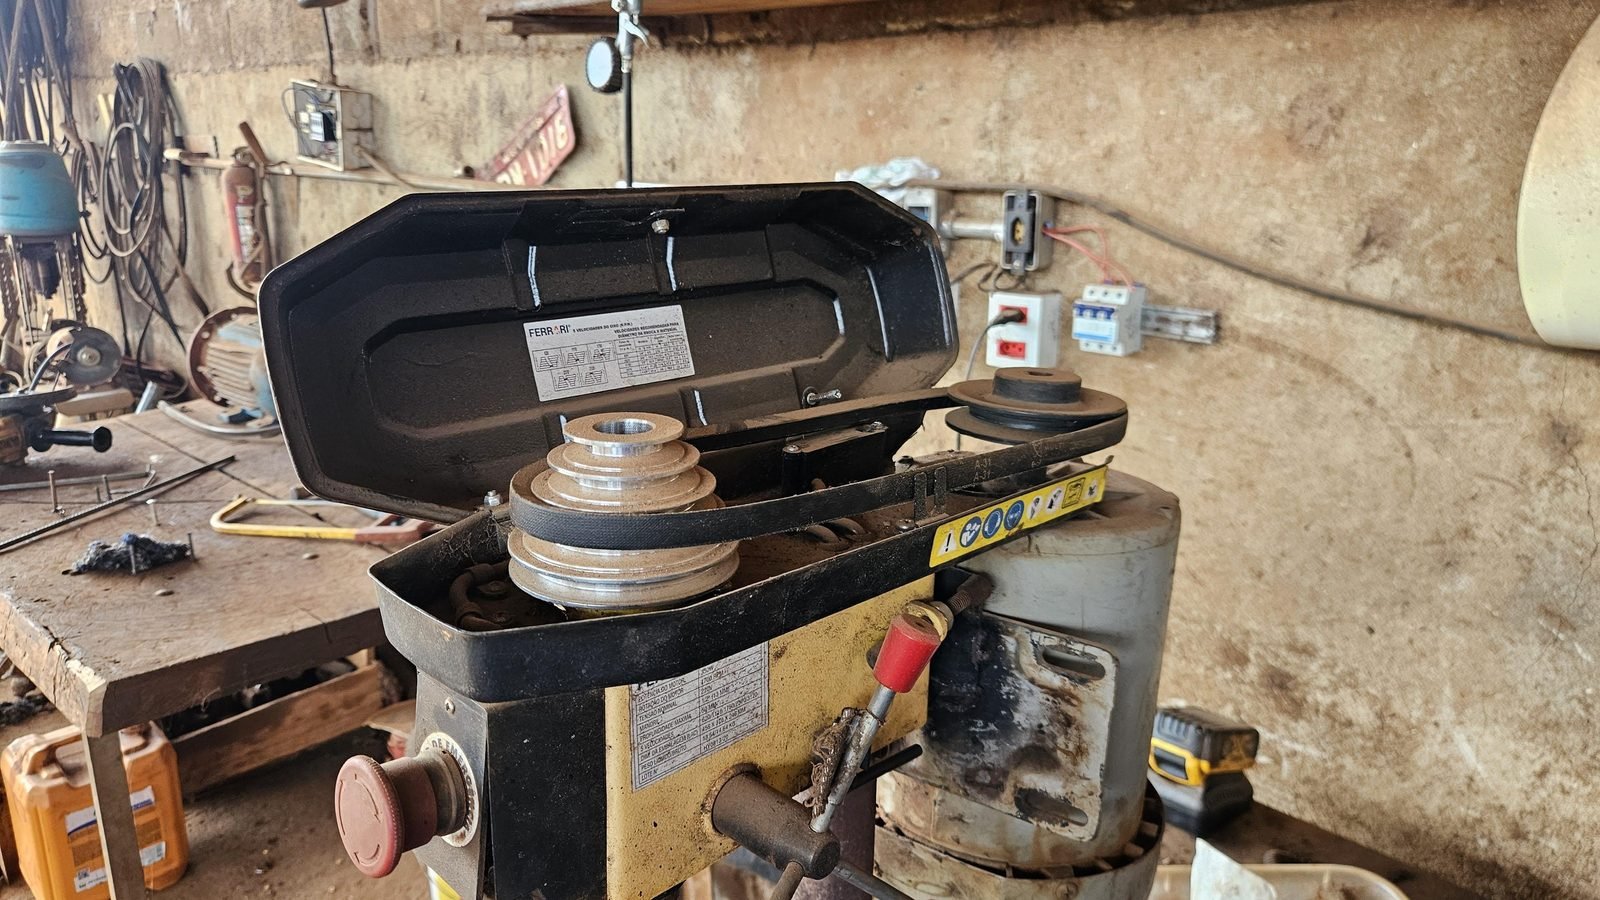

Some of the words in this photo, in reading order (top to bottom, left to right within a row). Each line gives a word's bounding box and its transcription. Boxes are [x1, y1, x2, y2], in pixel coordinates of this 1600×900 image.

[528, 324, 569, 338] FERRARI
[657, 699, 677, 714] NOMINAL
[639, 721, 673, 742] PROFUNDIDADE
[640, 758, 653, 771] PESO
[641, 769, 652, 781] LOTE
